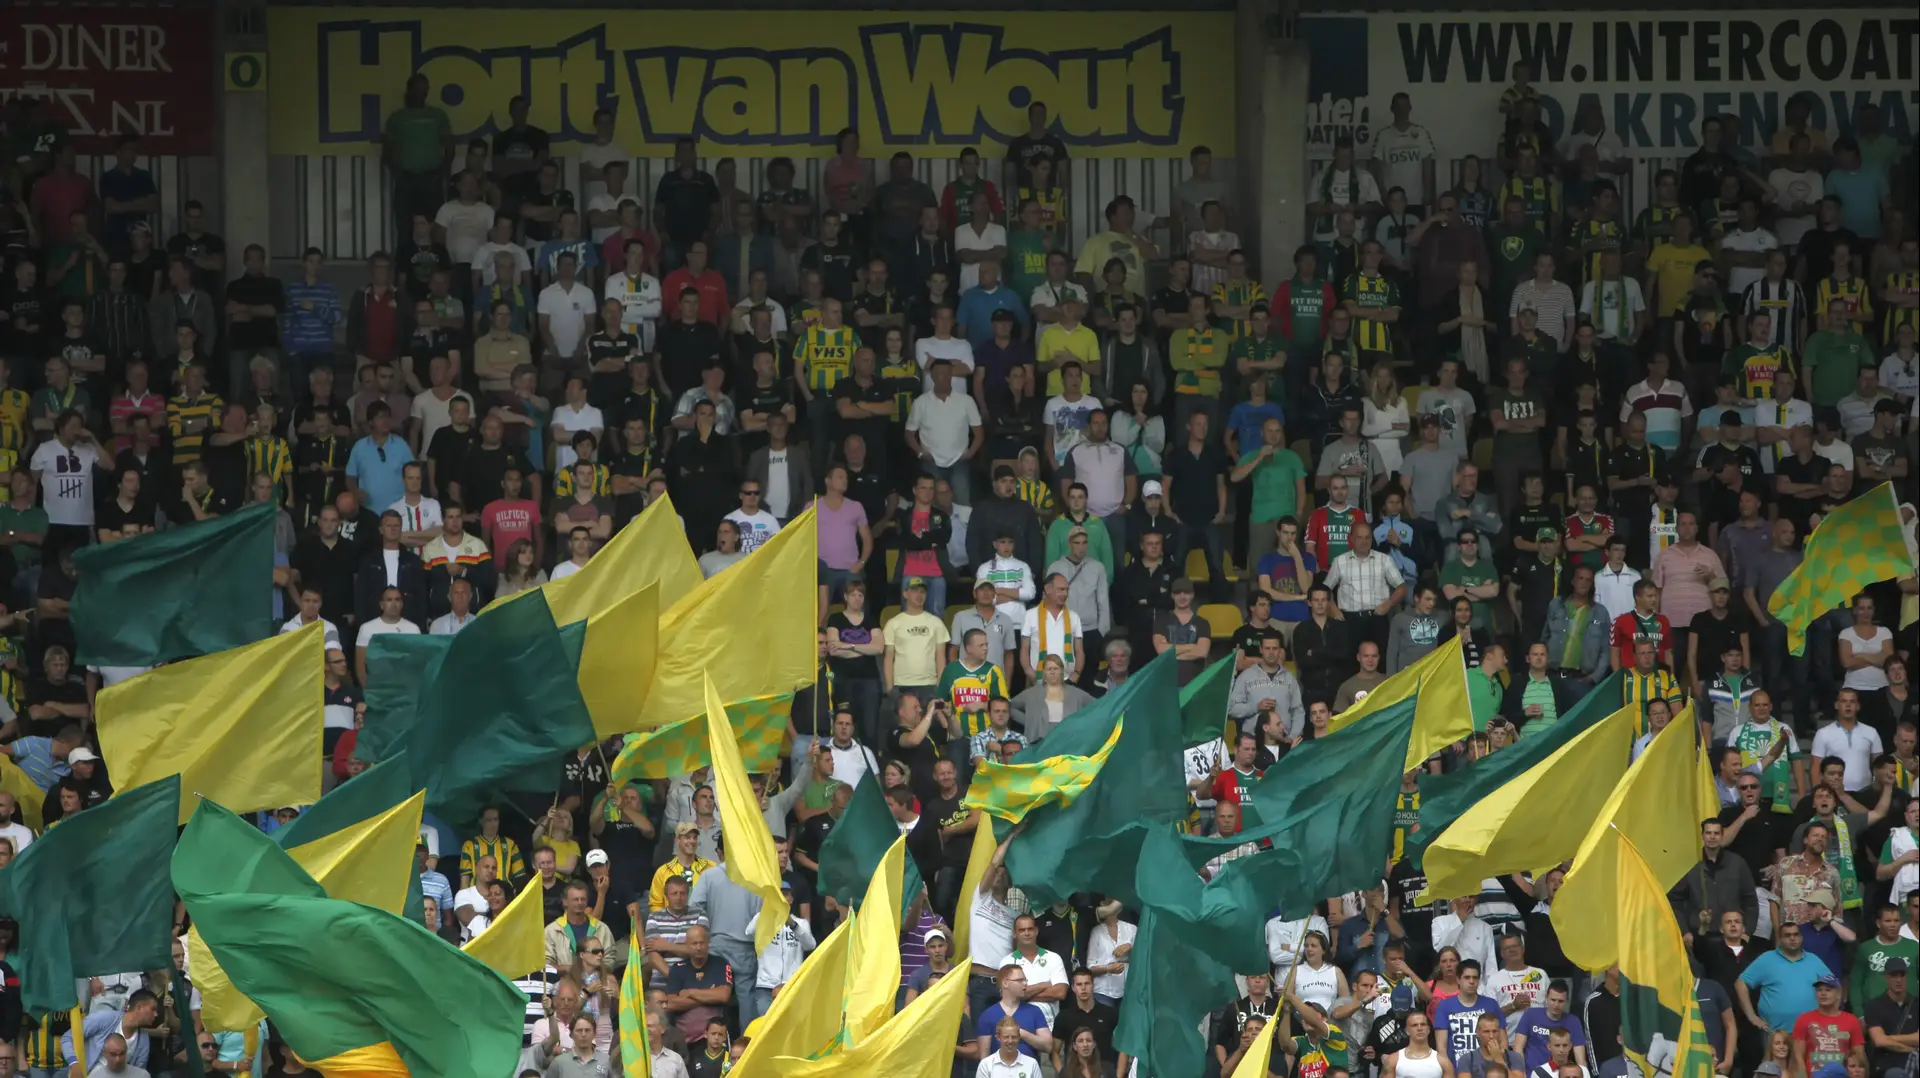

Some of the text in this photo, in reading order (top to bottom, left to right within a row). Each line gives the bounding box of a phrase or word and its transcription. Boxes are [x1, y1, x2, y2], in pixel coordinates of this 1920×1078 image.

[20, 24, 173, 73] DINER
[318, 20, 1185, 146] Hout van Wout
[0, 87, 174, 137] Z.NL
[1535, 90, 1919, 148] DAKRENOVA
[1306, 125, 1369, 144] ATING
[1389, 151, 1421, 164] DSW
[813, 347, 845, 358] VHS
[56, 455, 82, 473] BB
[1193, 754, 1210, 776] 33
[1233, 786, 1249, 794] FIT
[1501, 983, 1541, 993] FIT FOR
[1511, 991, 1537, 1001] FE
[1533, 1025, 1551, 1036] G-STA
